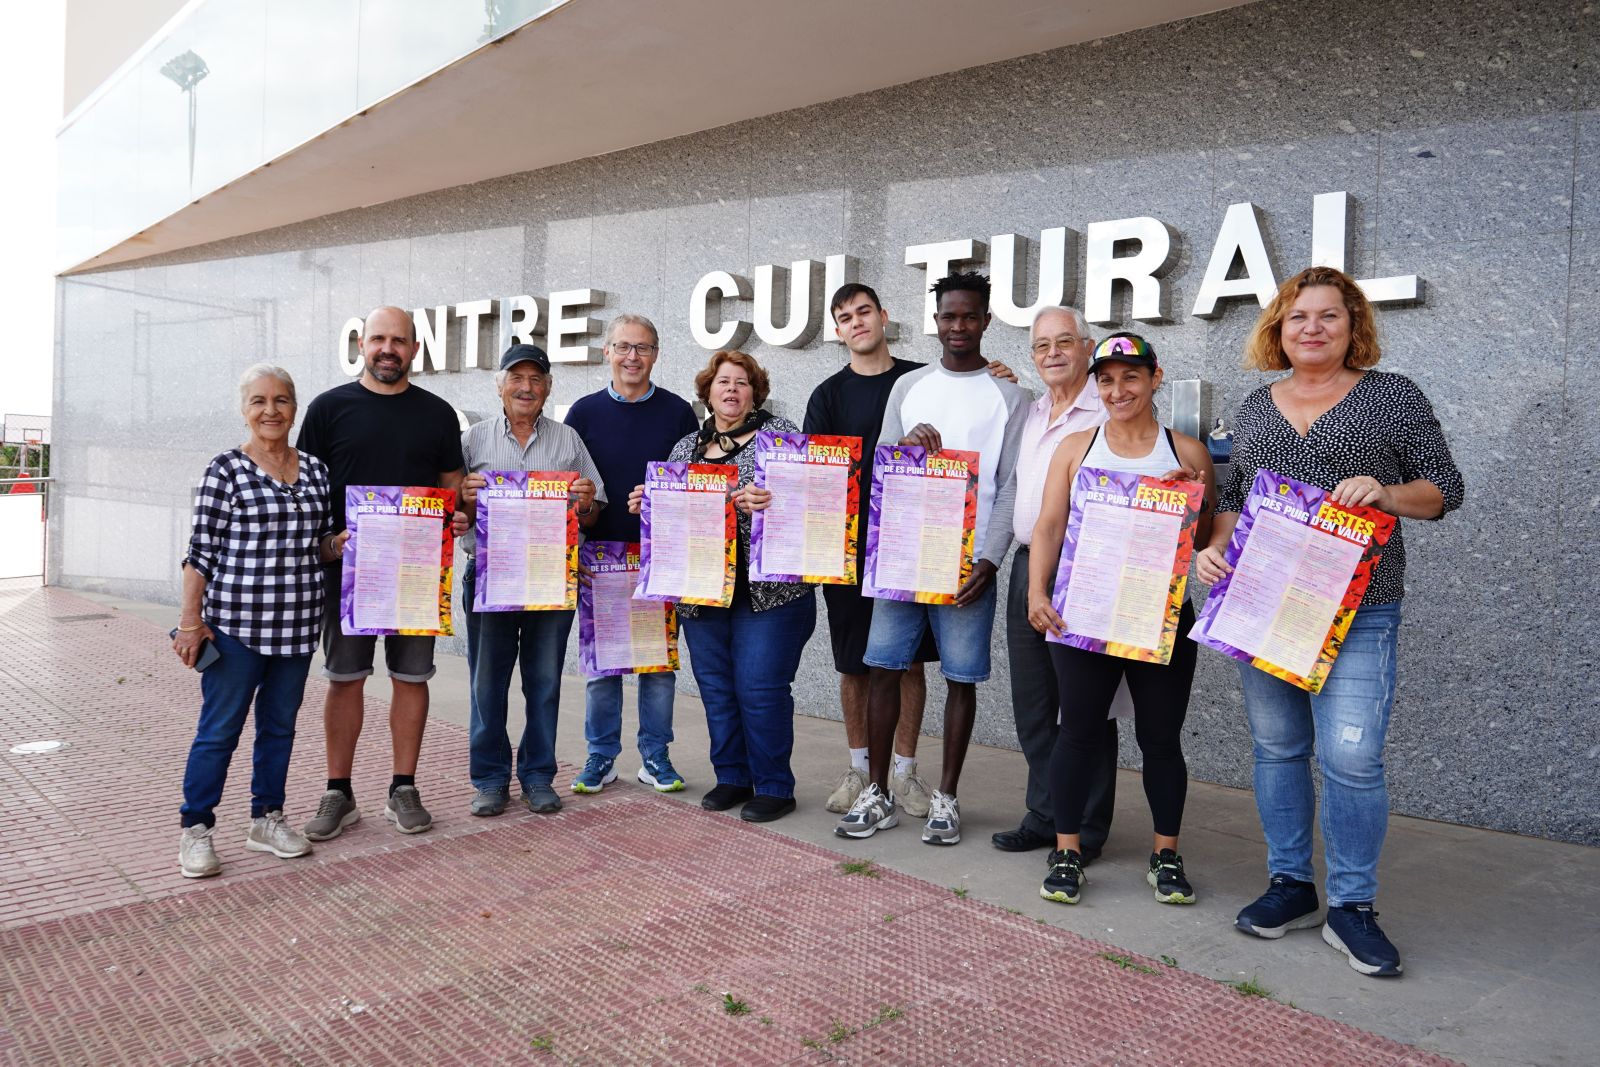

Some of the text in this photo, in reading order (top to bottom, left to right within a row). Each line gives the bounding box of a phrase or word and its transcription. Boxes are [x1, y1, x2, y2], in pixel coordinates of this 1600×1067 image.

[338, 288, 593, 377] CNTRE
[766, 452, 776, 460] DE
[827, 456, 849, 464] VALLS
[808, 444, 850, 458] FIESTAS
[926, 457, 968, 472] FIESTAS
[907, 466, 925, 475] PUIG
[927, 468, 943, 476] D'EN
[946, 469, 967, 478] VALLS
[528, 481, 568, 492] FESTES
[688, 474, 727, 485] FIESTAS
[402, 496, 444, 510] FESTES
[1087, 491, 1185, 514] DES PUIG D'EN VALLS
[1136, 486, 1187, 506] FESTES
[400, 506, 419, 514] D'EN
[421, 508, 444, 516] VALLS
[1261, 497, 1282, 512] DES
[1284, 505, 1310, 522] PUIG
[1310, 516, 1336, 532] D'EN
[1338, 525, 1370, 544] VALLS
[1317, 504, 1376, 536] FESTES
